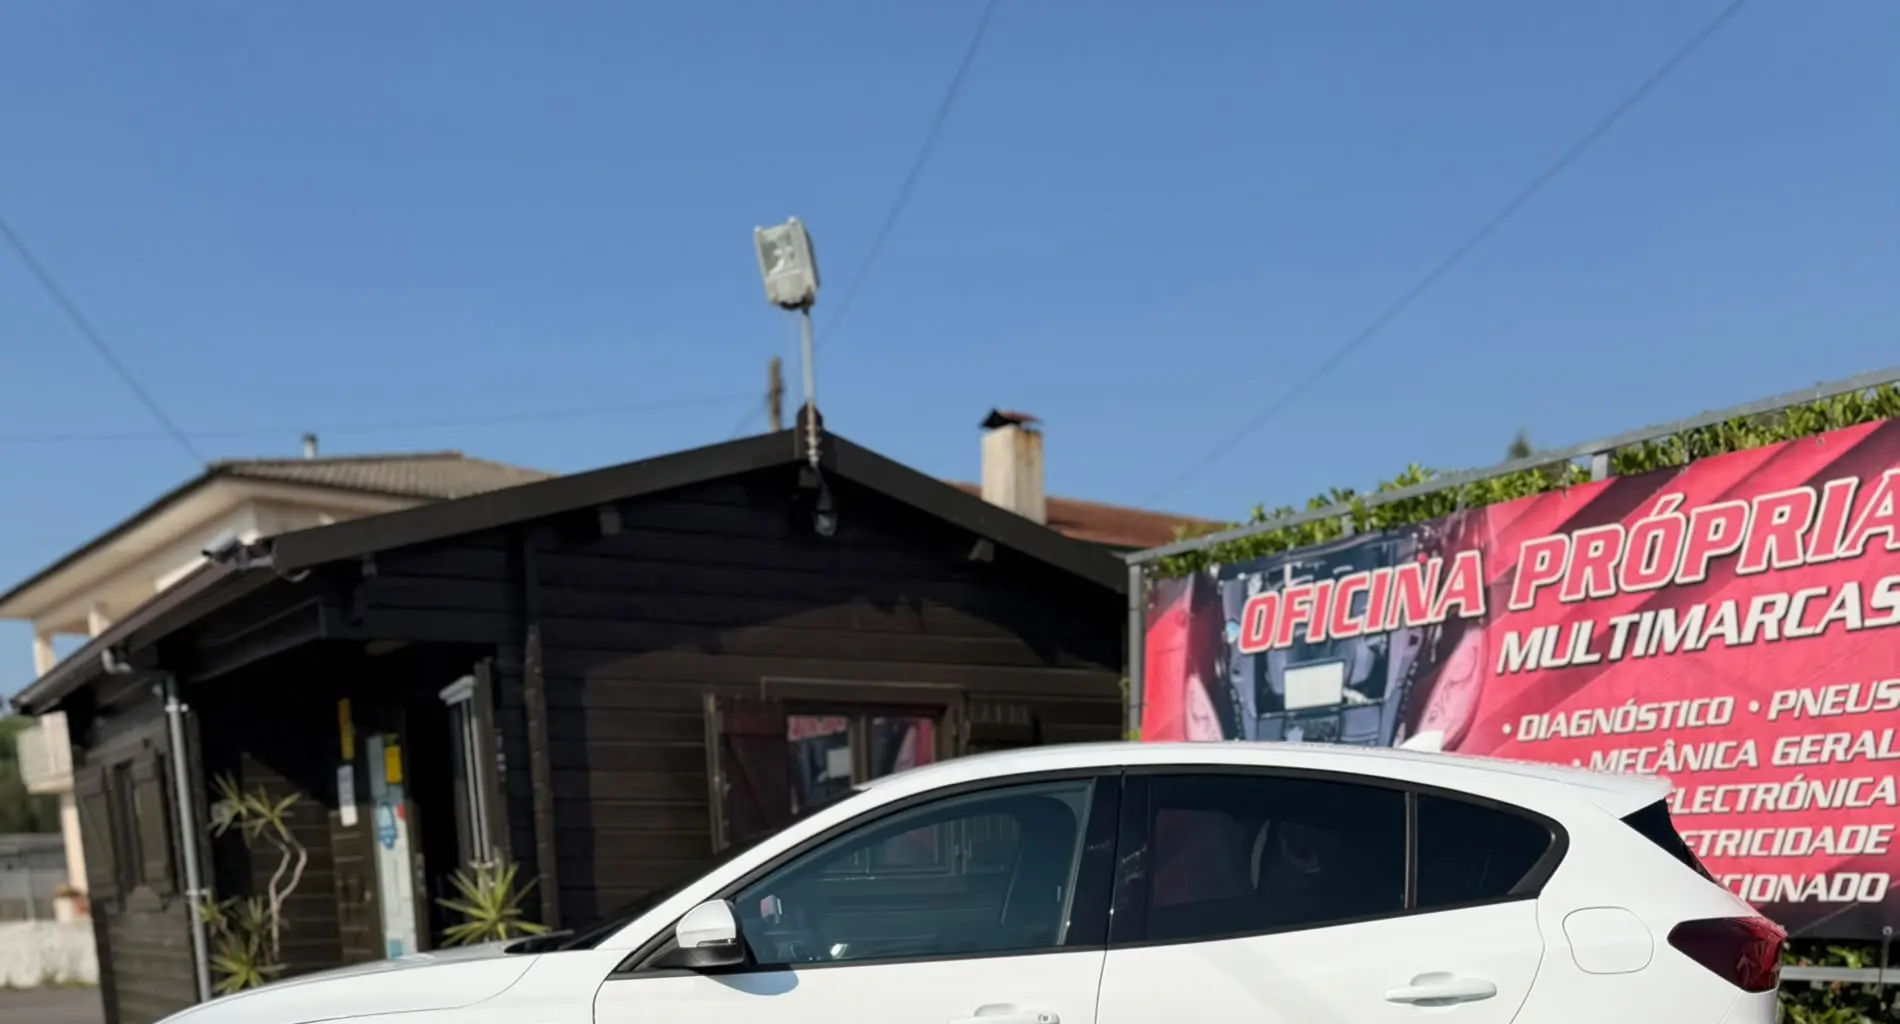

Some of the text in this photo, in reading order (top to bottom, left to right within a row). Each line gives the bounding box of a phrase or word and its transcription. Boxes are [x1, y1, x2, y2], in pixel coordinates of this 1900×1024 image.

[1239, 468, 1900, 653] OFICINA PRÓPRIA
[1496, 575, 1900, 674] MULTIMARCAS
[1517, 678, 1900, 741] DIAGNÓSTICO PNEUS
[1771, 728, 1900, 766] GERAL
